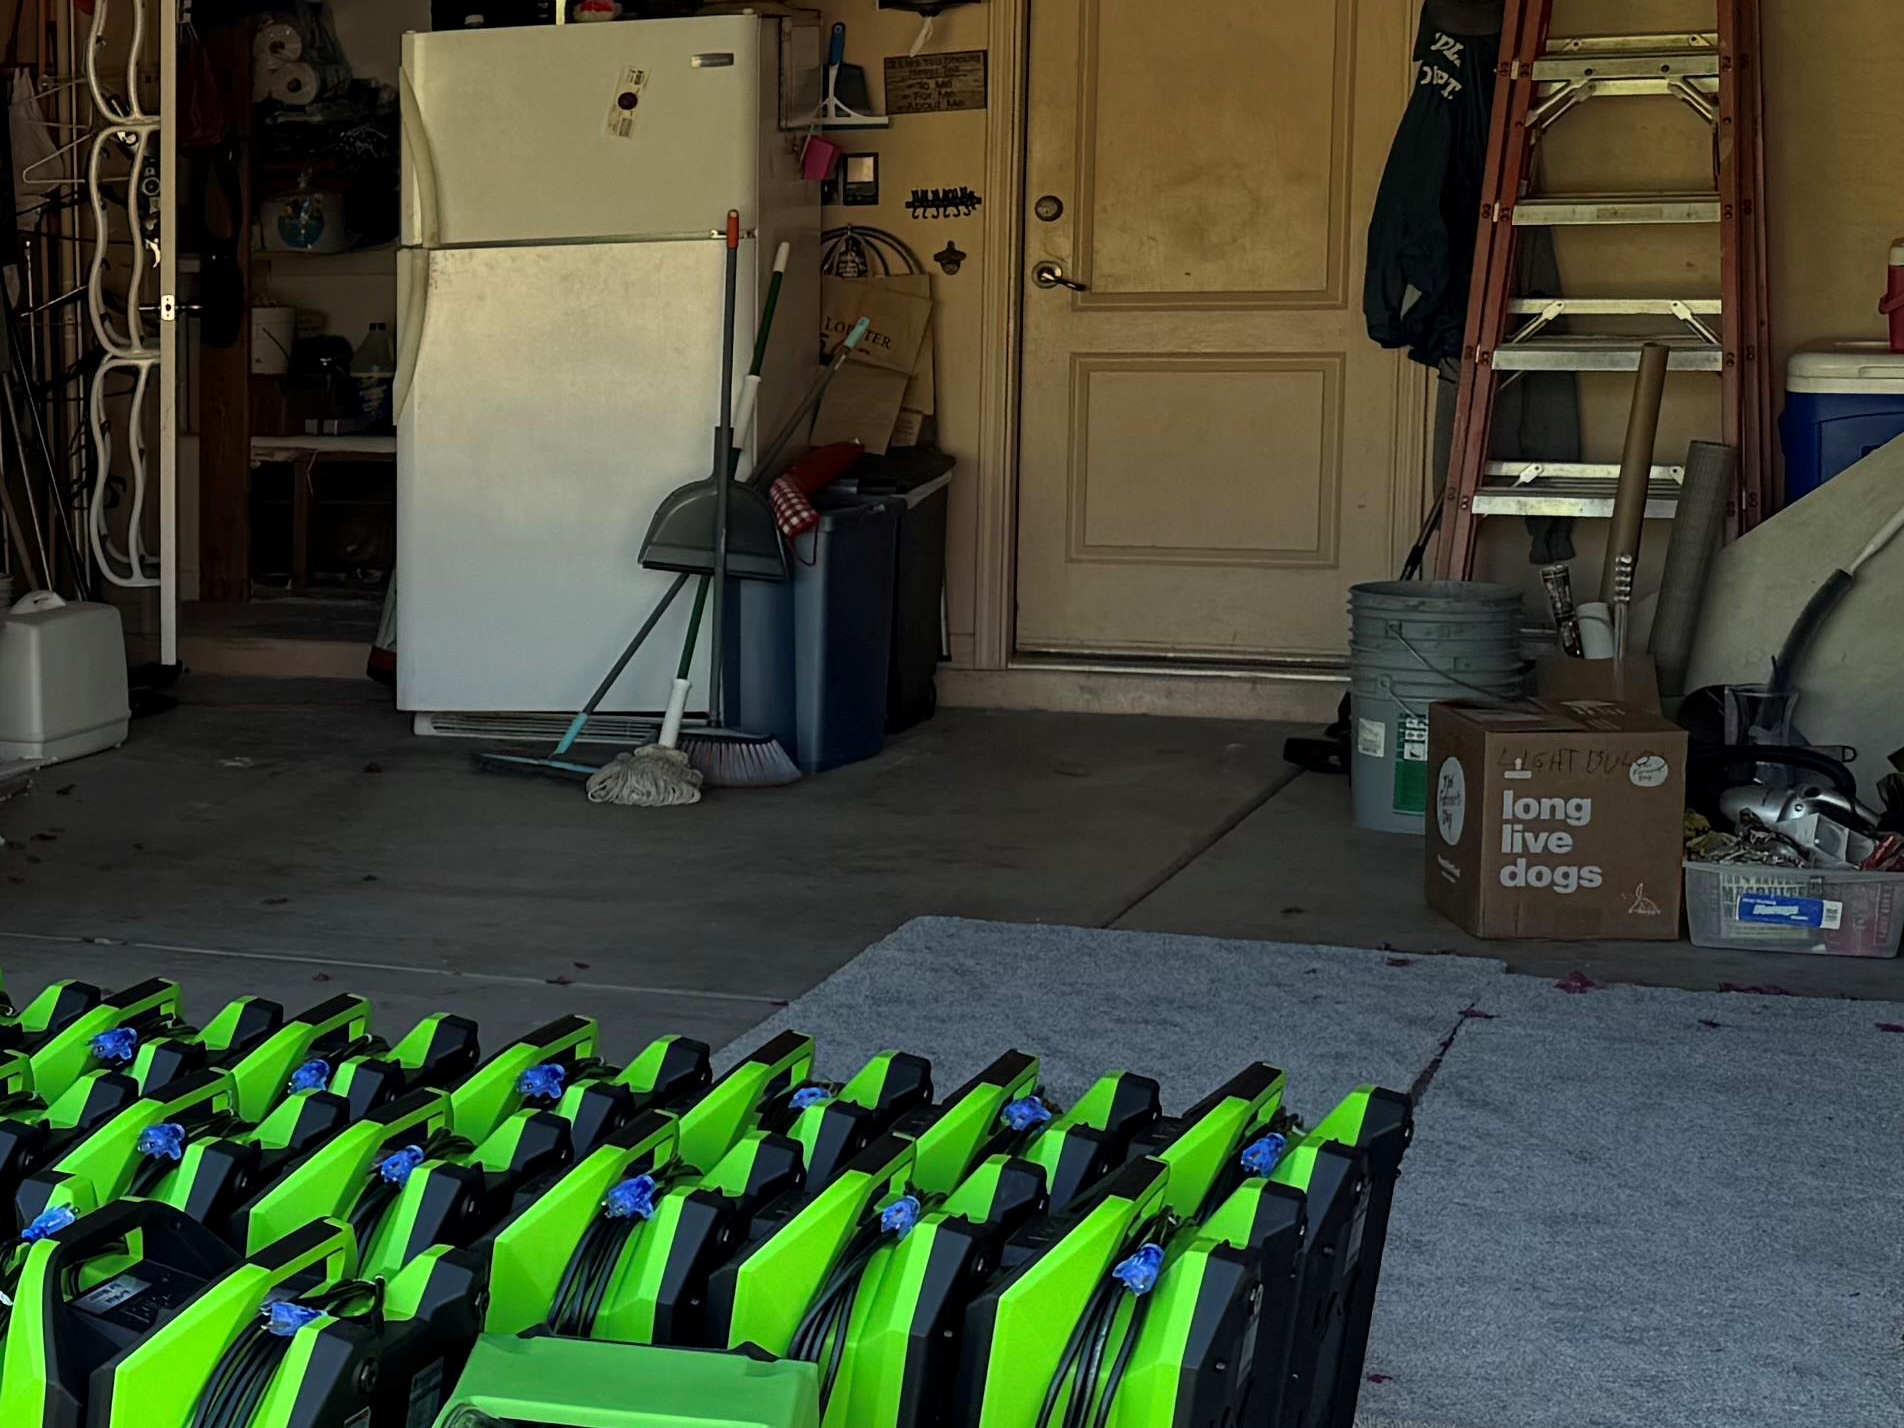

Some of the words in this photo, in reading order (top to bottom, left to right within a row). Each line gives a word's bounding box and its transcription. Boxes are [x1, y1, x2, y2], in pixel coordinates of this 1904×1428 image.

[1501, 790, 1592, 826] long
[1501, 824, 1574, 854] live
[1499, 858, 1603, 894] dogs
